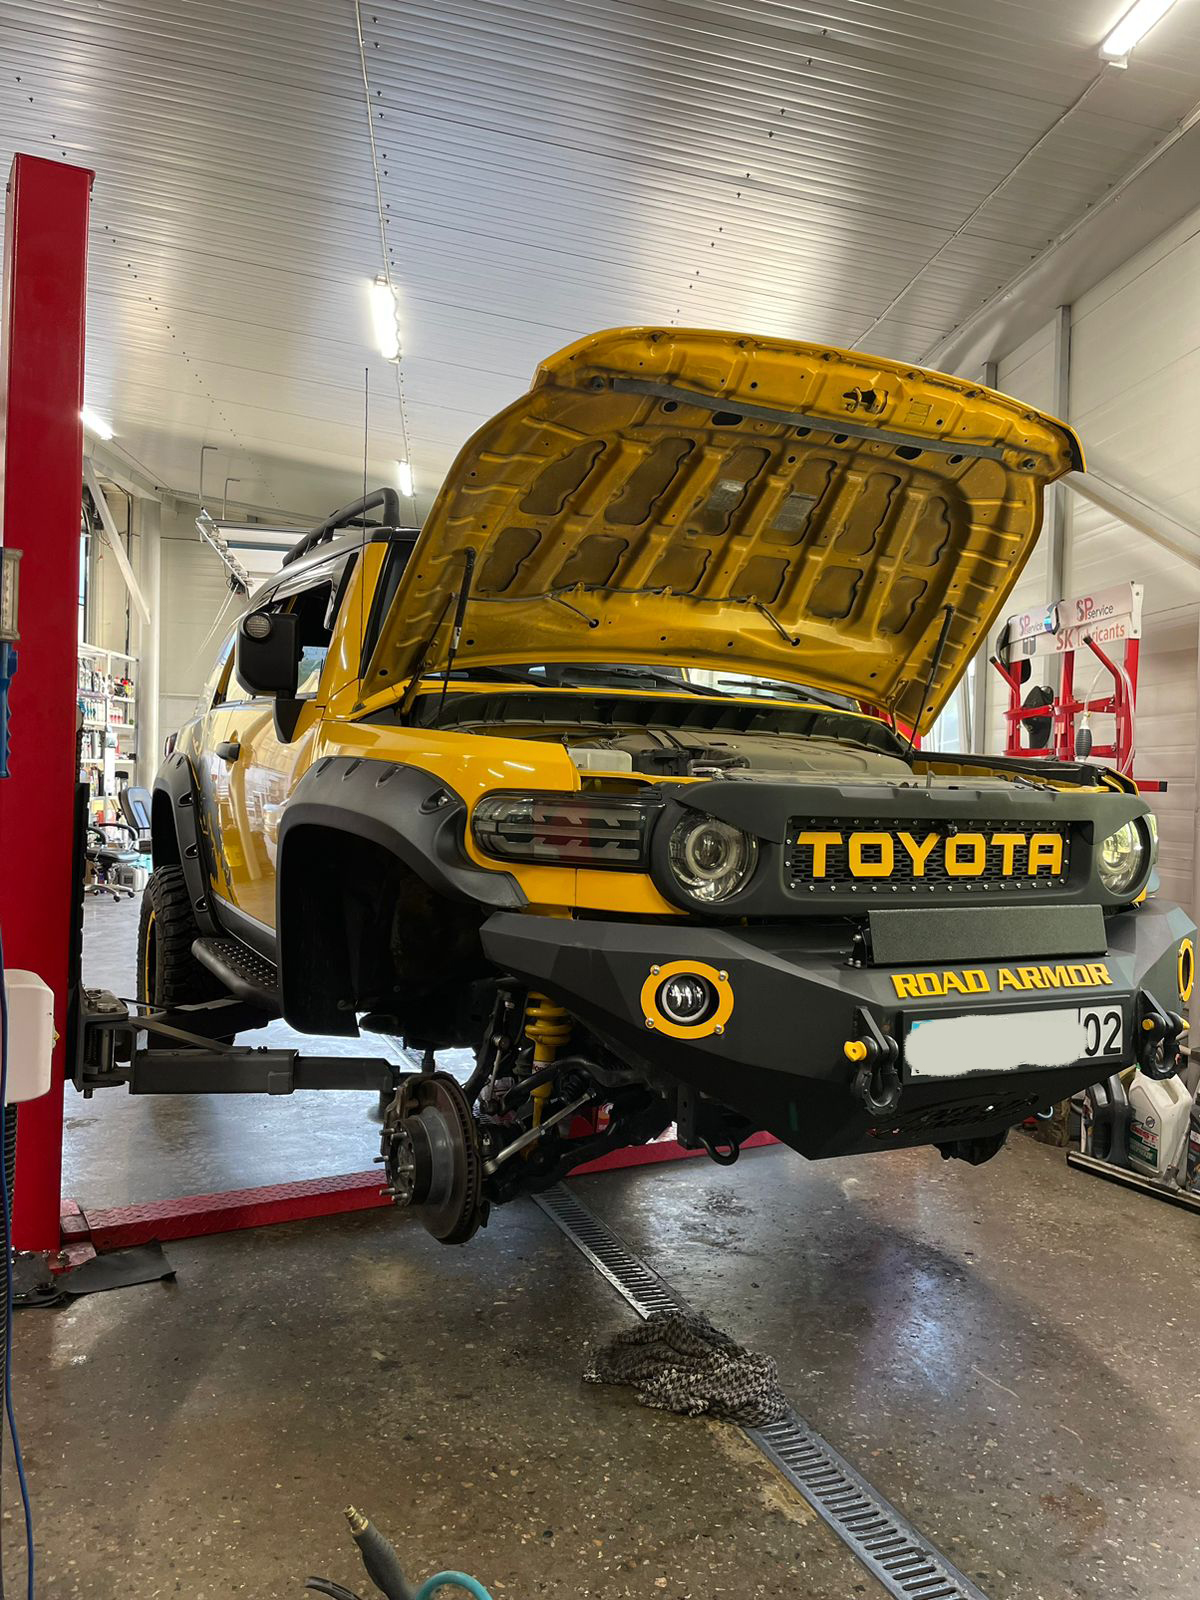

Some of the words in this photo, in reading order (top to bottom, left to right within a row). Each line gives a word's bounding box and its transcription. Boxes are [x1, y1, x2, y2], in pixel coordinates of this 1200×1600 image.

[1056, 628, 1075, 651] SK
[796, 831, 1064, 878] TOYOTA
[890, 969, 991, 999] ROAD
[998, 963, 1114, 991] ARMOR
[1083, 1011, 1122, 1057] 02
